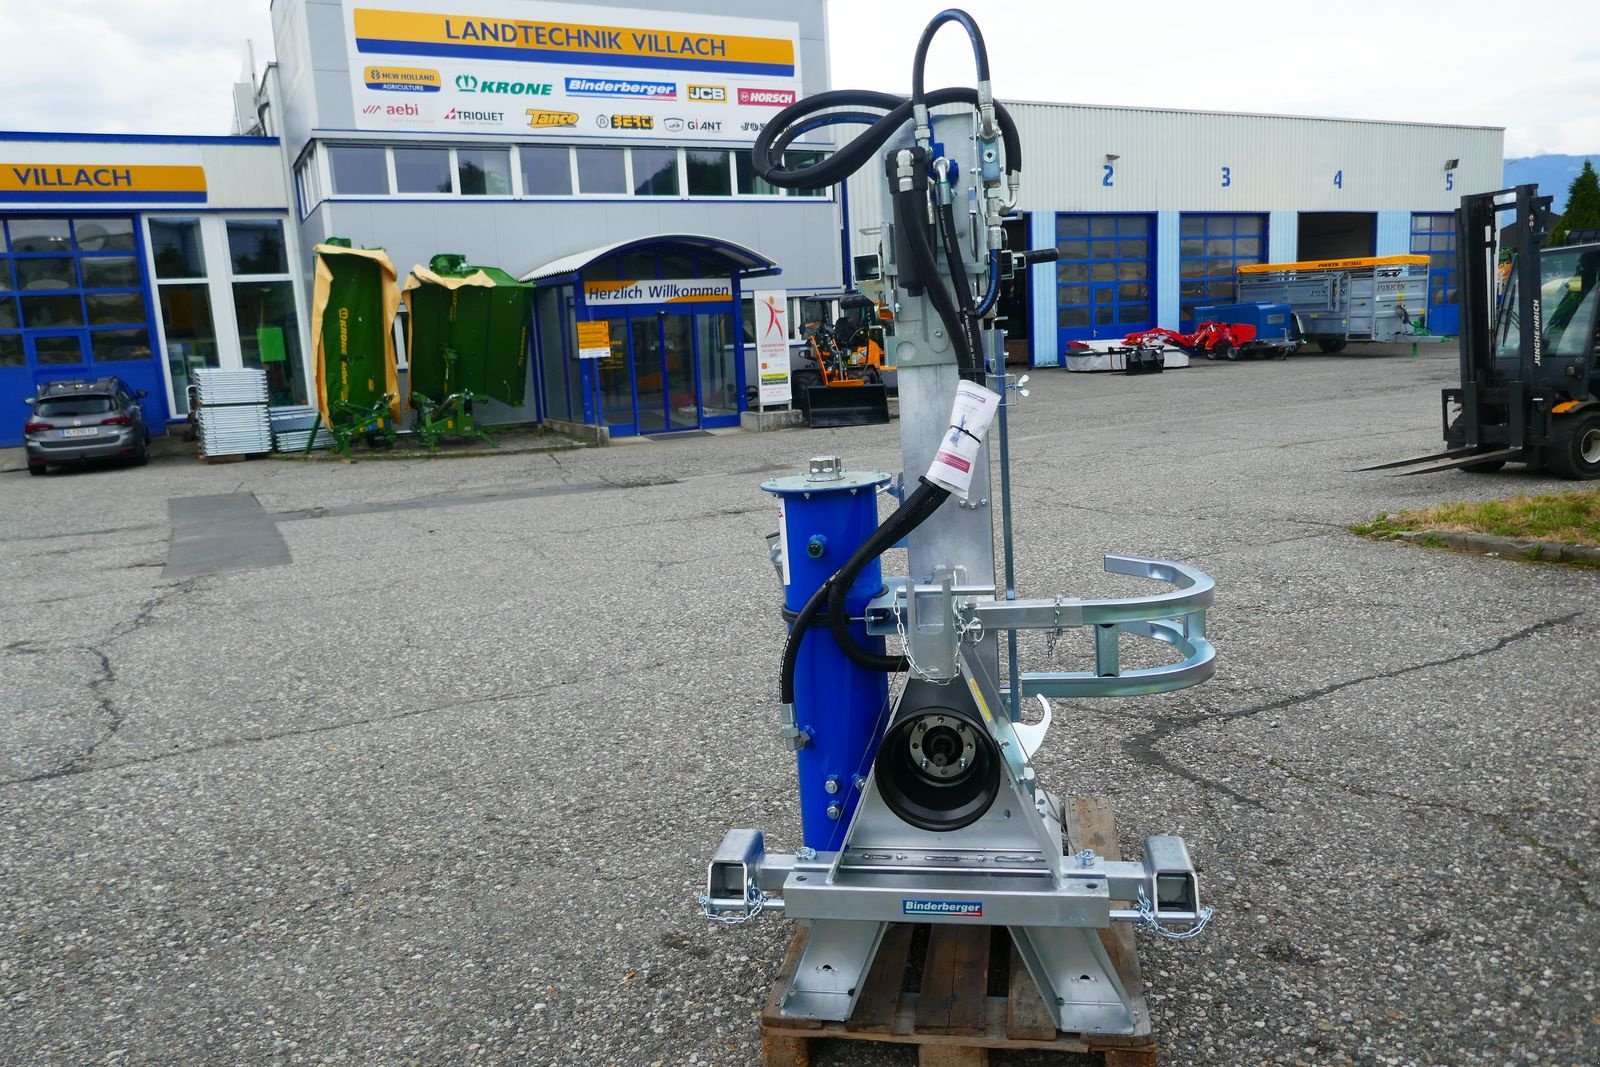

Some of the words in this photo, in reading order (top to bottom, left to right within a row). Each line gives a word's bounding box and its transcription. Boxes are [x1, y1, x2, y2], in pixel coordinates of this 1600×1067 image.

[445, 19, 623, 50] LANDTECHNIK
[632, 33, 726, 57] VILLACH
[400, 74, 435, 82] HOLLAND
[383, 83, 424, 92] AGRICULTURE
[480, 81, 553, 96] KRONE
[568, 79, 674, 96] Binderberger
[689, 86, 725, 100] JCB
[750, 92, 793, 104] HORSCH
[386, 104, 419, 116] aebi
[456, 111, 504, 122] TRIOLIET
[526, 109, 579, 128] Tanco
[12, 167, 133, 187] VILLACH
[1102, 165, 1114, 187] 2
[1221, 167, 1231, 188] 3
[1333, 170, 1343, 189] 4
[1445, 173, 1454, 192] 5
[589, 285, 643, 301] Herzlich
[649, 283, 730, 298] Willkommen
[340, 320, 348, 355] KRONE
[1533, 299, 1541, 367] JUNGHEINRICH
[905, 901, 981, 913] Binderberger
